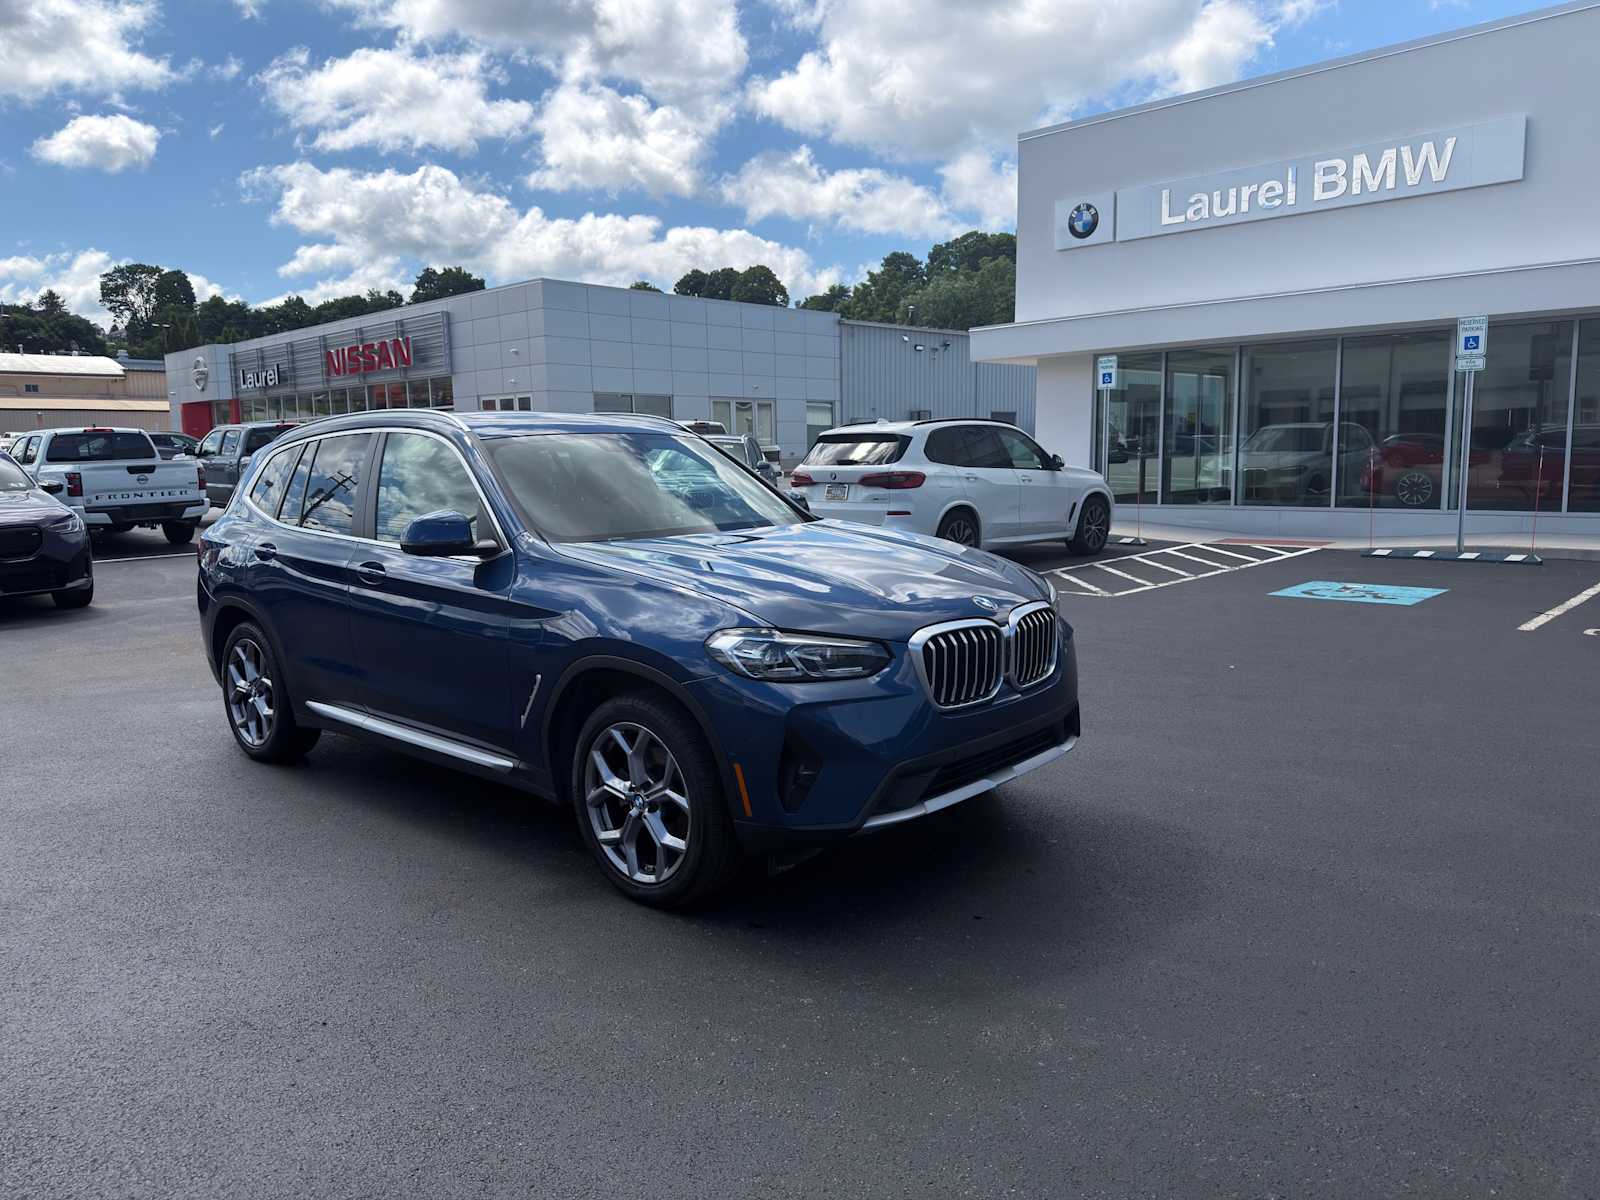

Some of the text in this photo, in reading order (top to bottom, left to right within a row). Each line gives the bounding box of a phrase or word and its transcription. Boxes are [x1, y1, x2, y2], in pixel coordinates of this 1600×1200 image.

[1161, 137, 1457, 226] Laurel BMW
[326, 336, 412, 377] NISSAN
[239, 363, 280, 390] Laurel
[95, 490, 188, 501] FRONTIER
